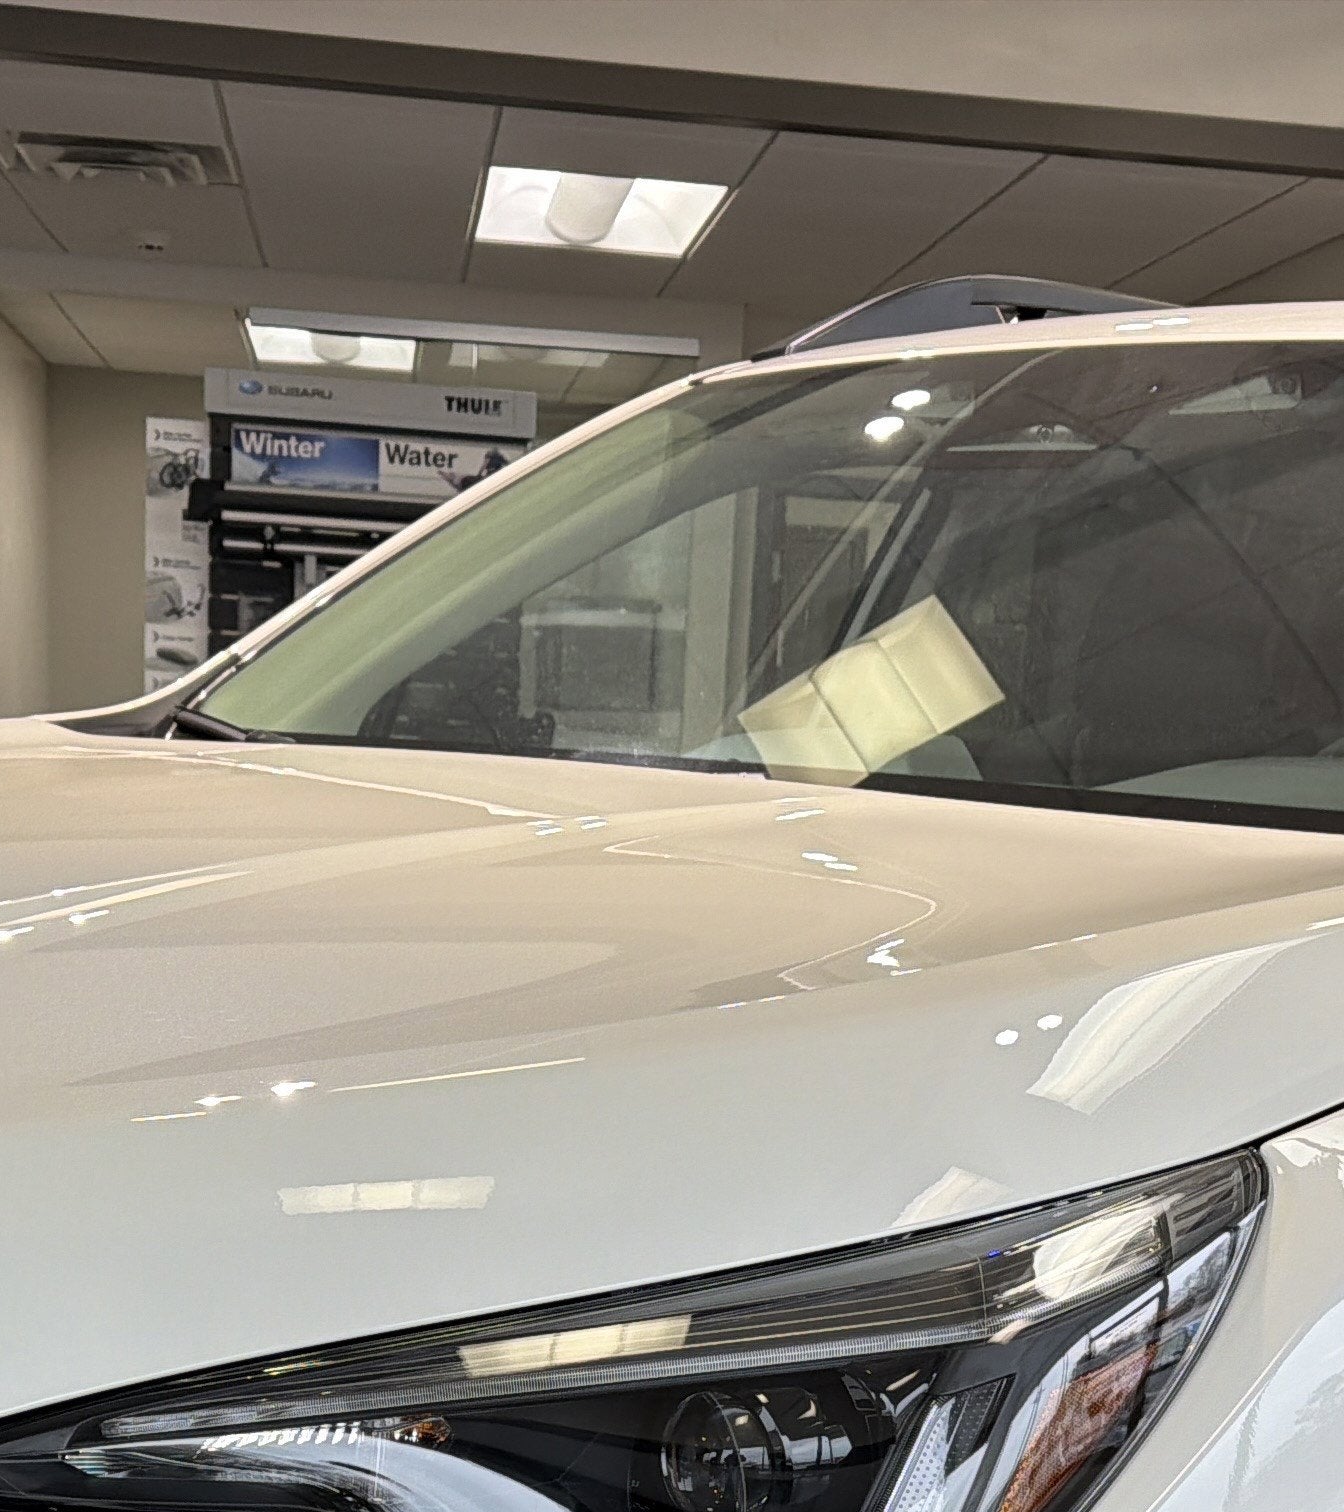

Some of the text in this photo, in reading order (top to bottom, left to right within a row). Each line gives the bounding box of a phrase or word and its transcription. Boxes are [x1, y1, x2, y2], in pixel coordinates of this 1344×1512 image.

[267, 384, 333, 400] SUBARU
[239, 430, 326, 459] Winter
[384, 441, 459, 469] Water
